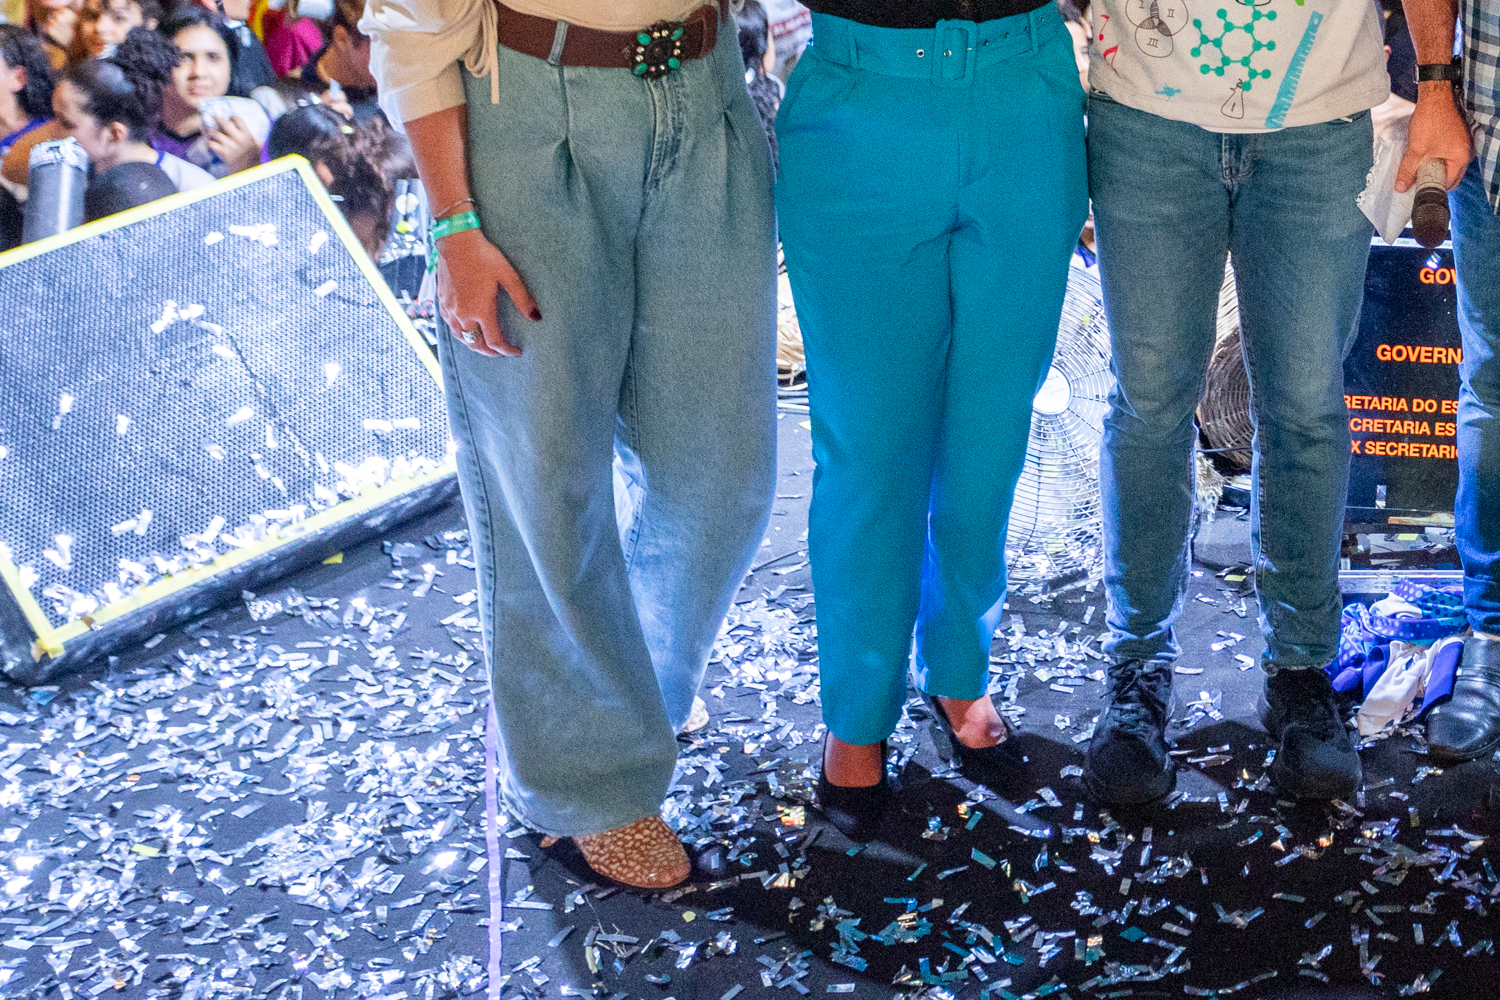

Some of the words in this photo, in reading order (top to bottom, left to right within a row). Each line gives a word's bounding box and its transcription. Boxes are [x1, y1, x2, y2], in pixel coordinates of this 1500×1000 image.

[1376, 344, 1464, 364] GOVERN
[1412, 398, 1438, 413] DO
[1349, 417, 1431, 435] CRETARIA
[1434, 422, 1457, 437] ES
[1364, 441, 1458, 459] SECRETARI
